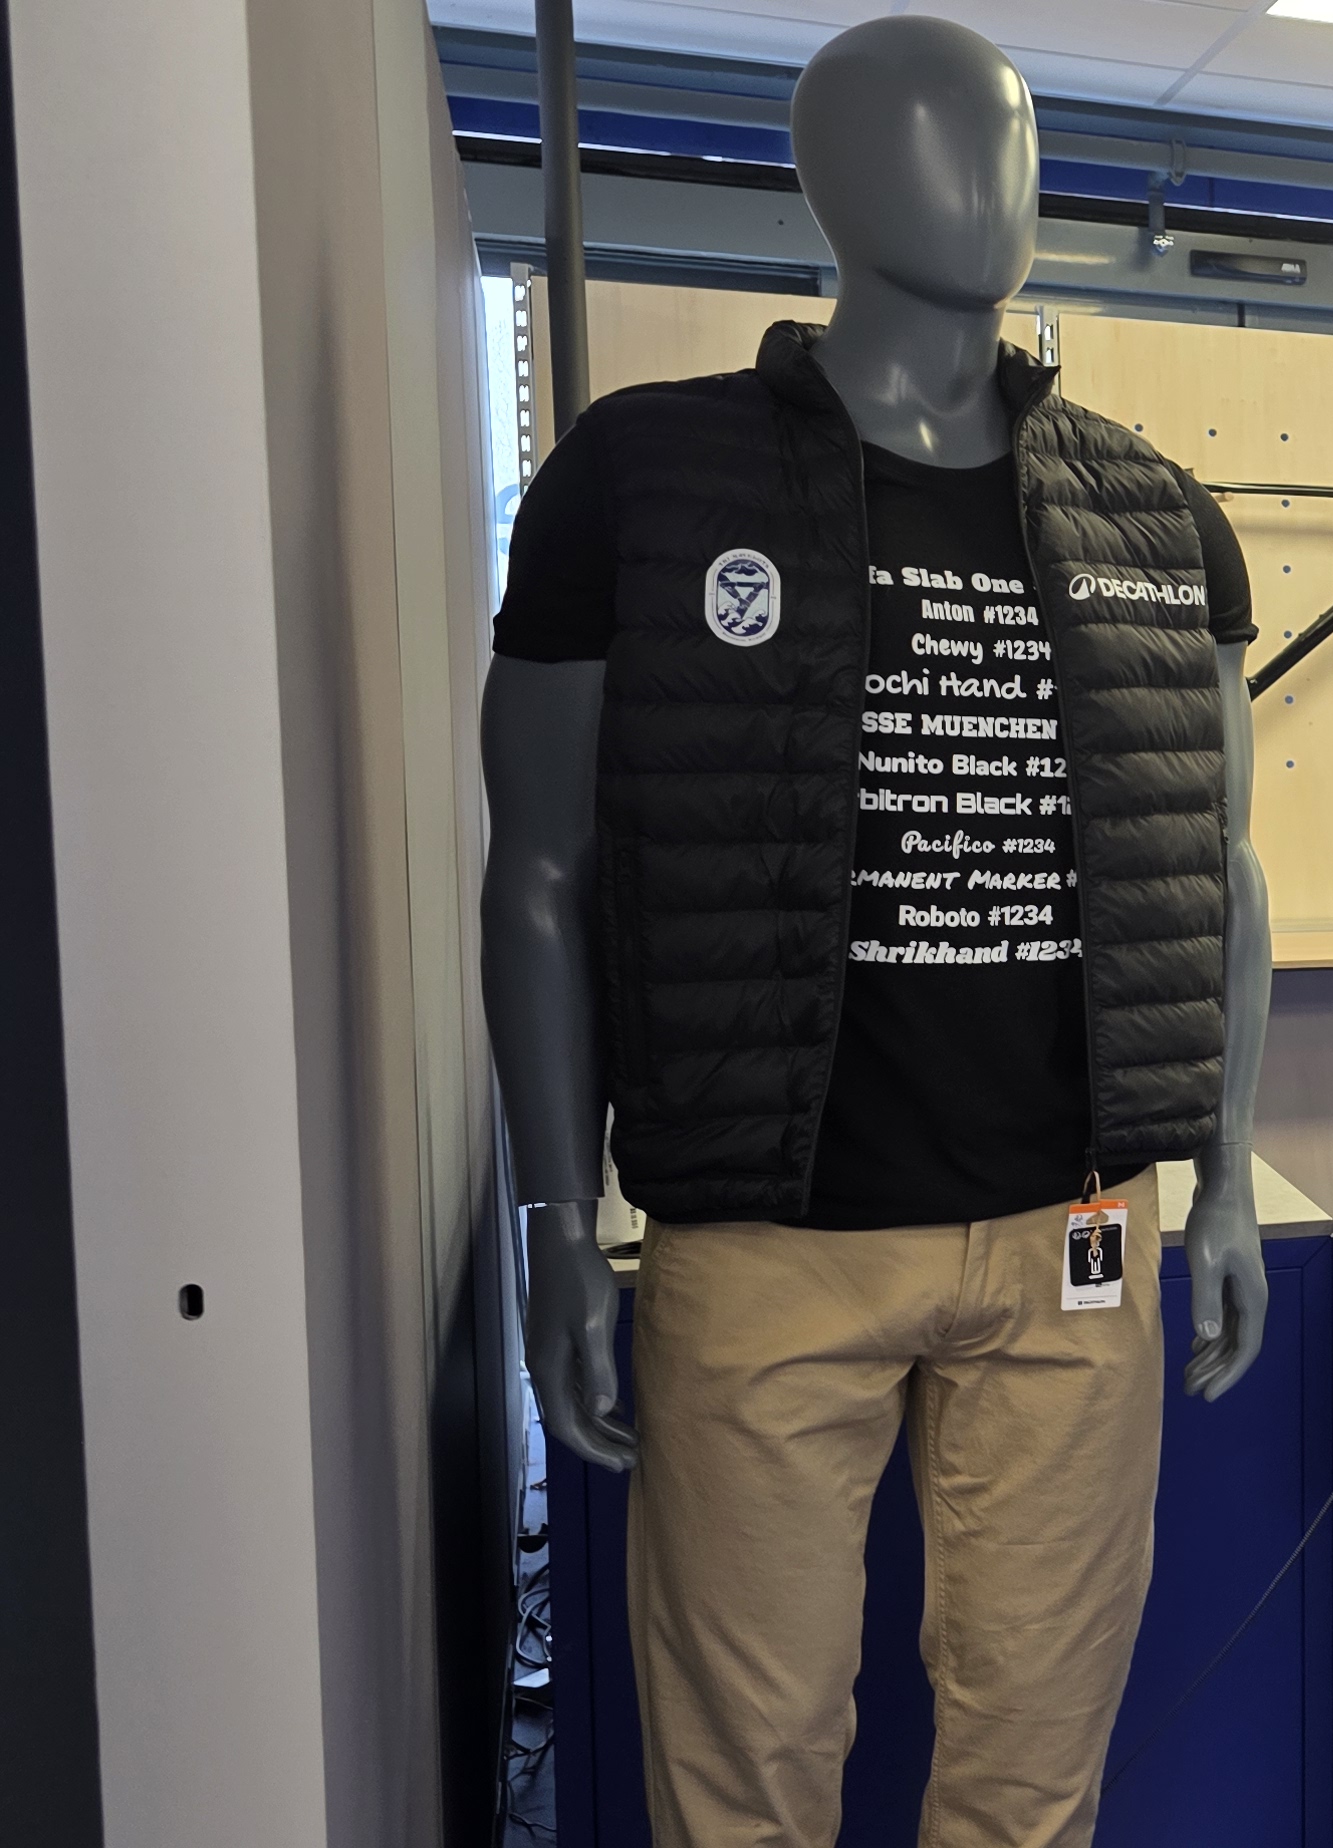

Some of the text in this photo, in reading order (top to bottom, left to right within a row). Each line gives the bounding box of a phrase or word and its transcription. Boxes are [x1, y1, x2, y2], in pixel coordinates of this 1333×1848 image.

[901, 566, 963, 590] Slab
[971, 572, 1025, 594] One
[1097, 577, 1206, 606] DECATHLON
[921, 599, 1039, 625] Anton #1234
[911, 632, 1052, 664] Chewy #1234
[939, 672, 1027, 700] Hand
[921, 713, 1058, 740] MUENCHEN
[858, 751, 944, 774] Nunito
[952, 753, 1018, 776] Black
[857, 788, 949, 813] bitron
[956, 791, 1032, 815] Black
[901, 829, 1056, 859] Pacifico #1234
[898, 904, 1053, 927] Roboto #1234
[849, 939, 1009, 964] Shrikhand
